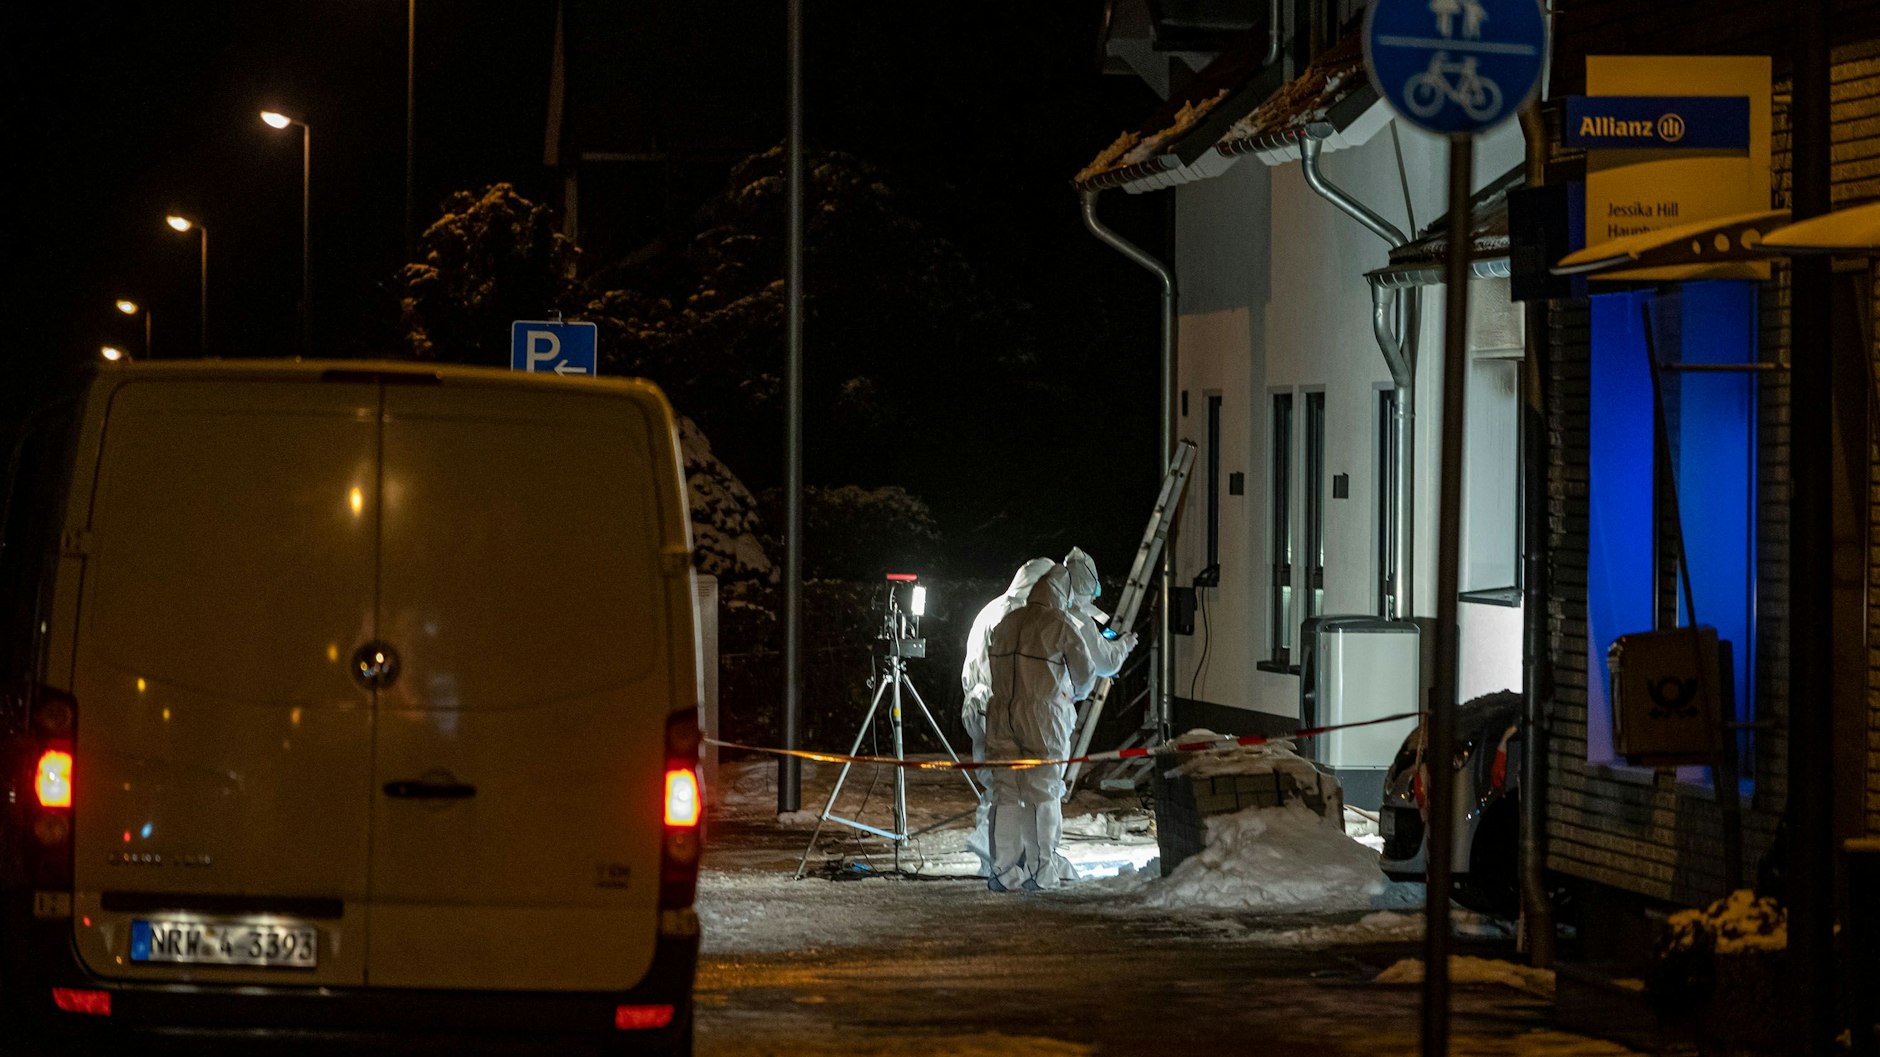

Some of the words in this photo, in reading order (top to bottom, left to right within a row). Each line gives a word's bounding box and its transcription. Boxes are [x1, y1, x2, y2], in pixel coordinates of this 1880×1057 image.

[1579, 116, 1653, 137] Allianz
[1607, 201, 1653, 217] Jessika
[1657, 202, 1679, 217] Hill
[526, 330, 561, 372] P
